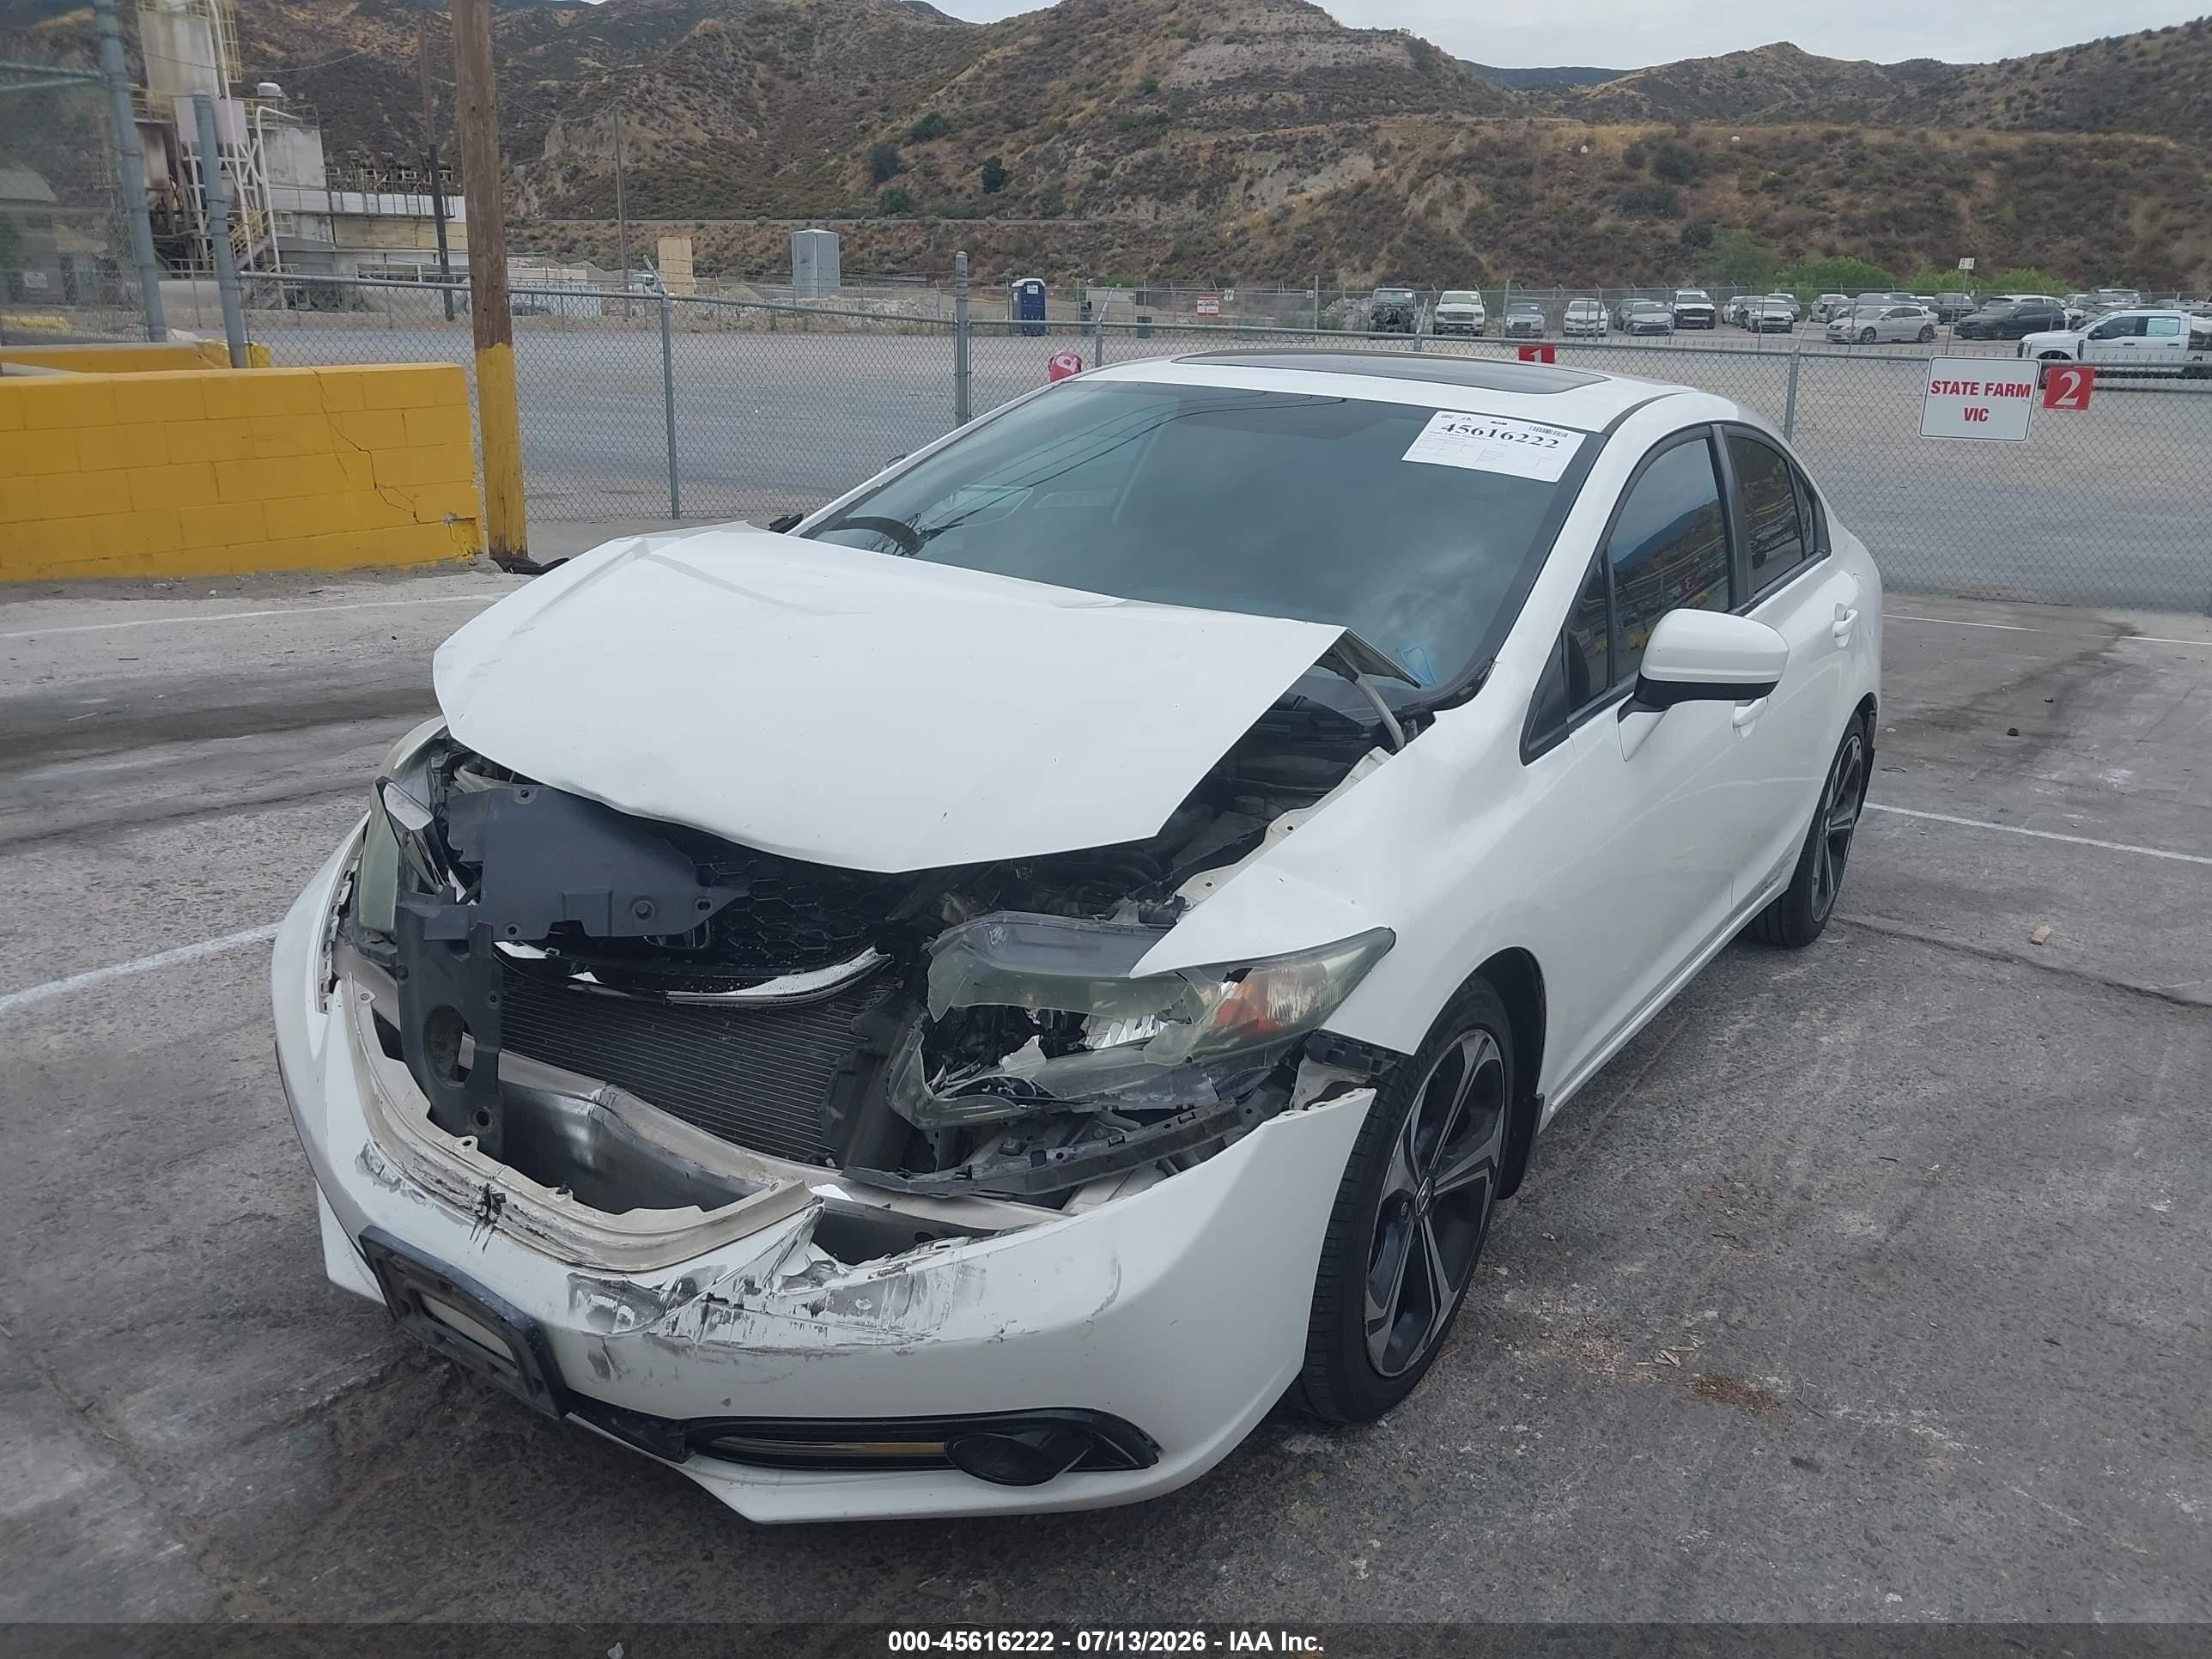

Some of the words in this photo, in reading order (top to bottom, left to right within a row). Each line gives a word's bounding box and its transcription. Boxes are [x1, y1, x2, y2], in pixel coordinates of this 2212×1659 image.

[1929, 380, 1979, 397] STATE
[1984, 382, 2032, 398] FARM
[2054, 371, 2081, 405] 2
[1963, 407, 1990, 422] VIC
[1441, 422, 1559, 449] 45616222
